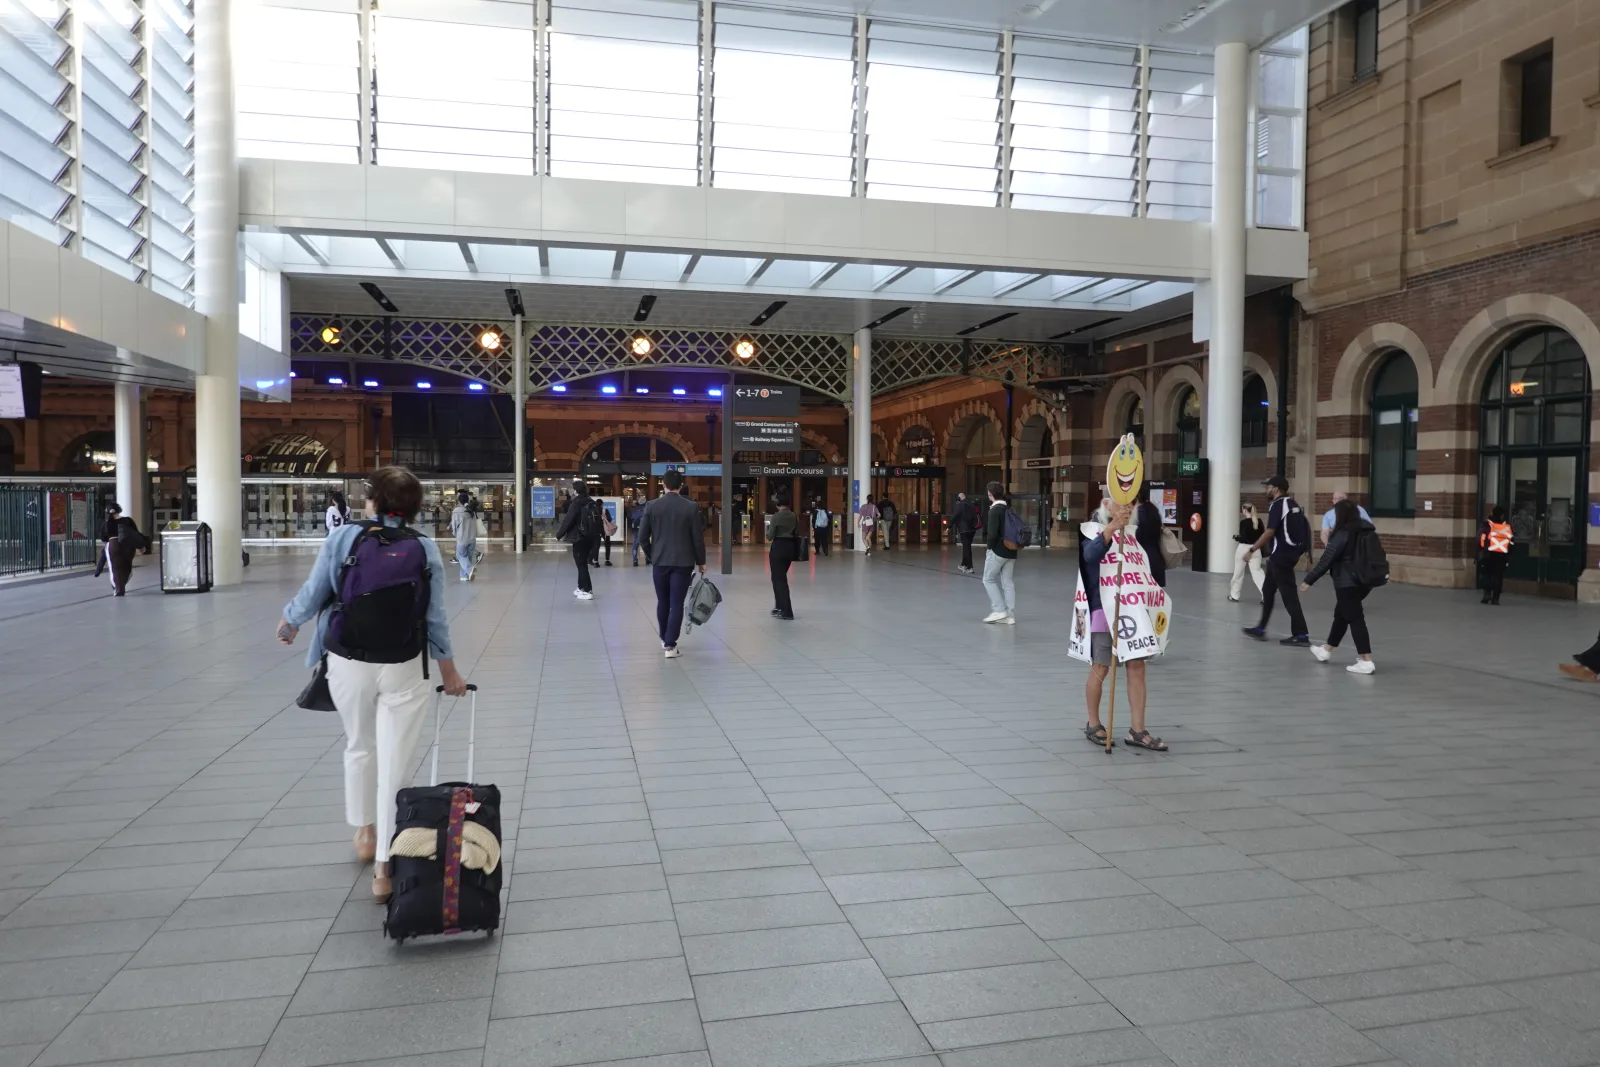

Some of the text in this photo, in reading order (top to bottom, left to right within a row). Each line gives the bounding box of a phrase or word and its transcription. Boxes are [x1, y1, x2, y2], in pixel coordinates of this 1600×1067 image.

[1100, 572, 1144, 586] MORE
[1114, 589, 1164, 607] NOT WAR
[1127, 636, 1156, 652] PEACE
